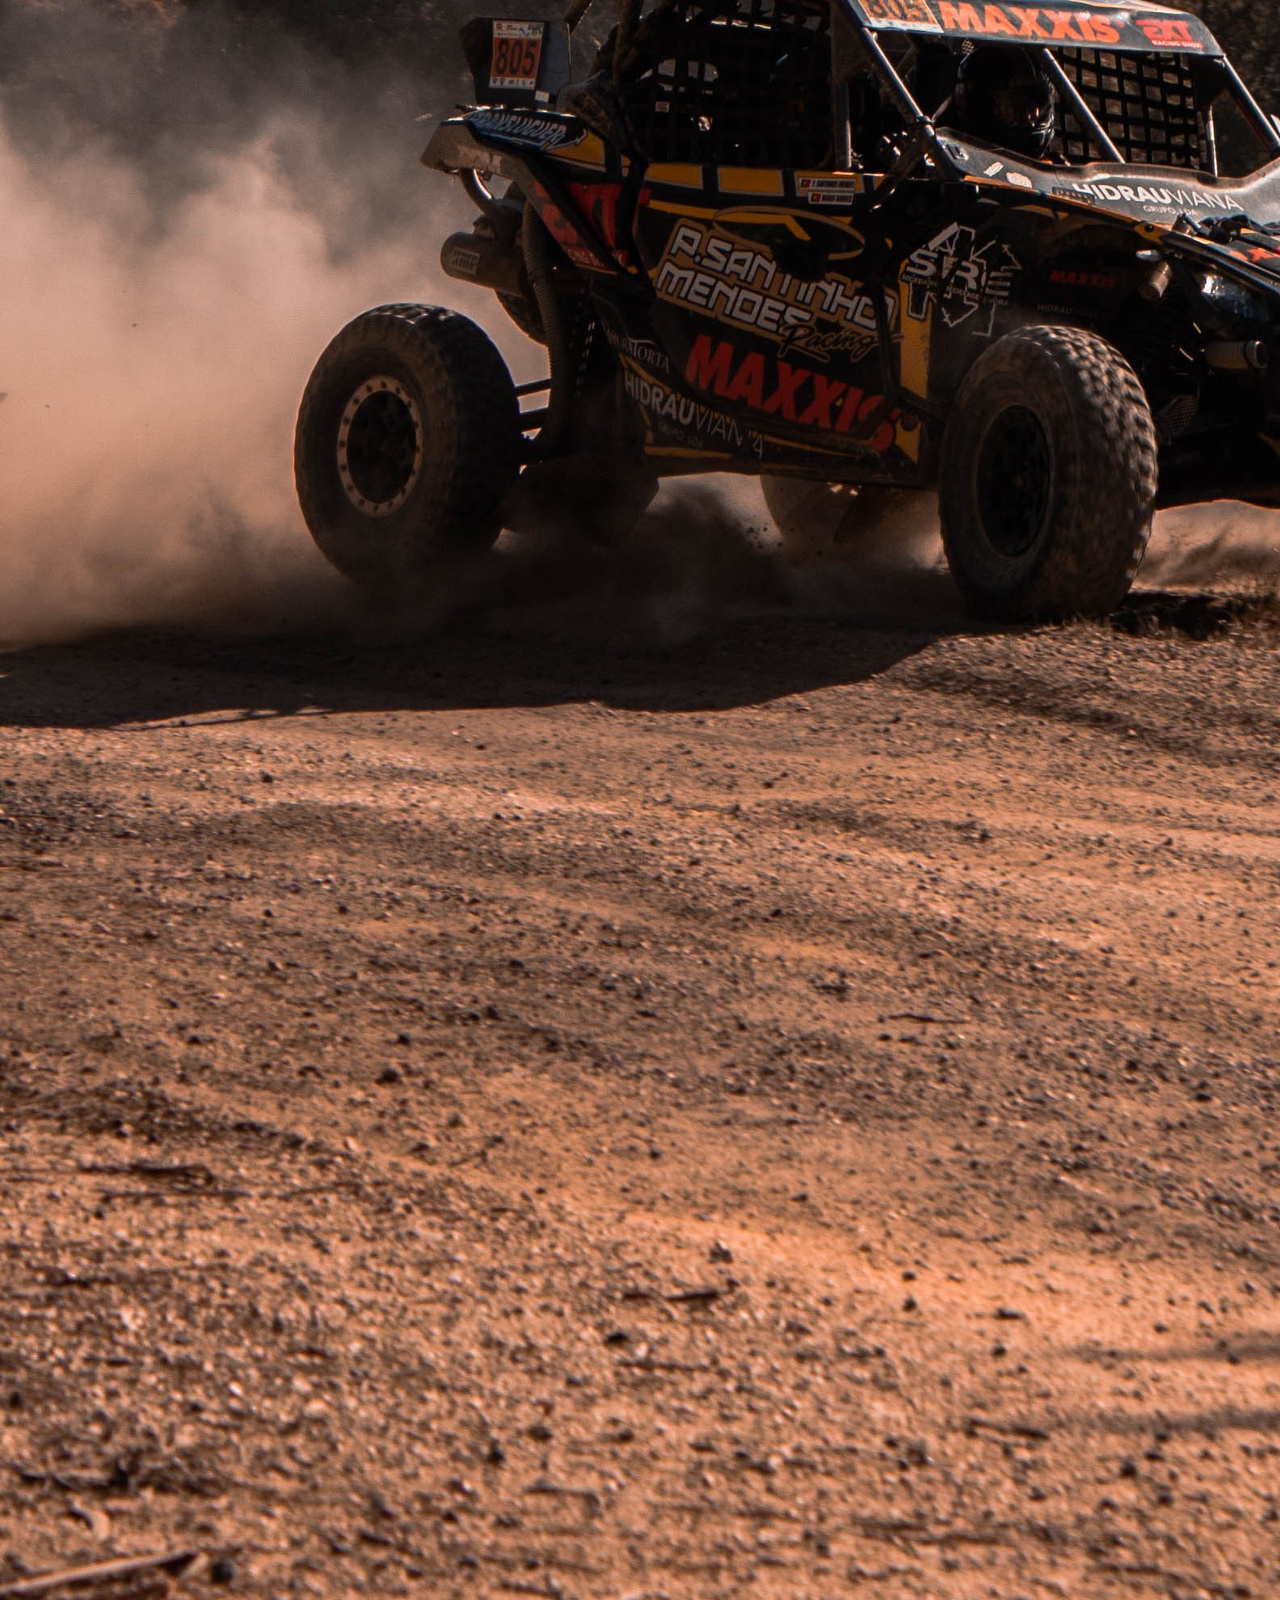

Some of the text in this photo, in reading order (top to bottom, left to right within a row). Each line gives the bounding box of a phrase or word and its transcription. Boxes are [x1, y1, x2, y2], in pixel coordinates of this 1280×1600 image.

[938, 0, 1121, 44] MAXXIS
[495, 38, 536, 76] 805
[1072, 182, 1245, 212] HIDRAUVIANA
[656, 261, 815, 335] MENDES
[1049, 269, 1115, 288] MAXXIS
[777, 322, 884, 363] Racing
[684, 333, 897, 451] MAXXIS
[624, 369, 764, 460] HIDRAUVIANA
